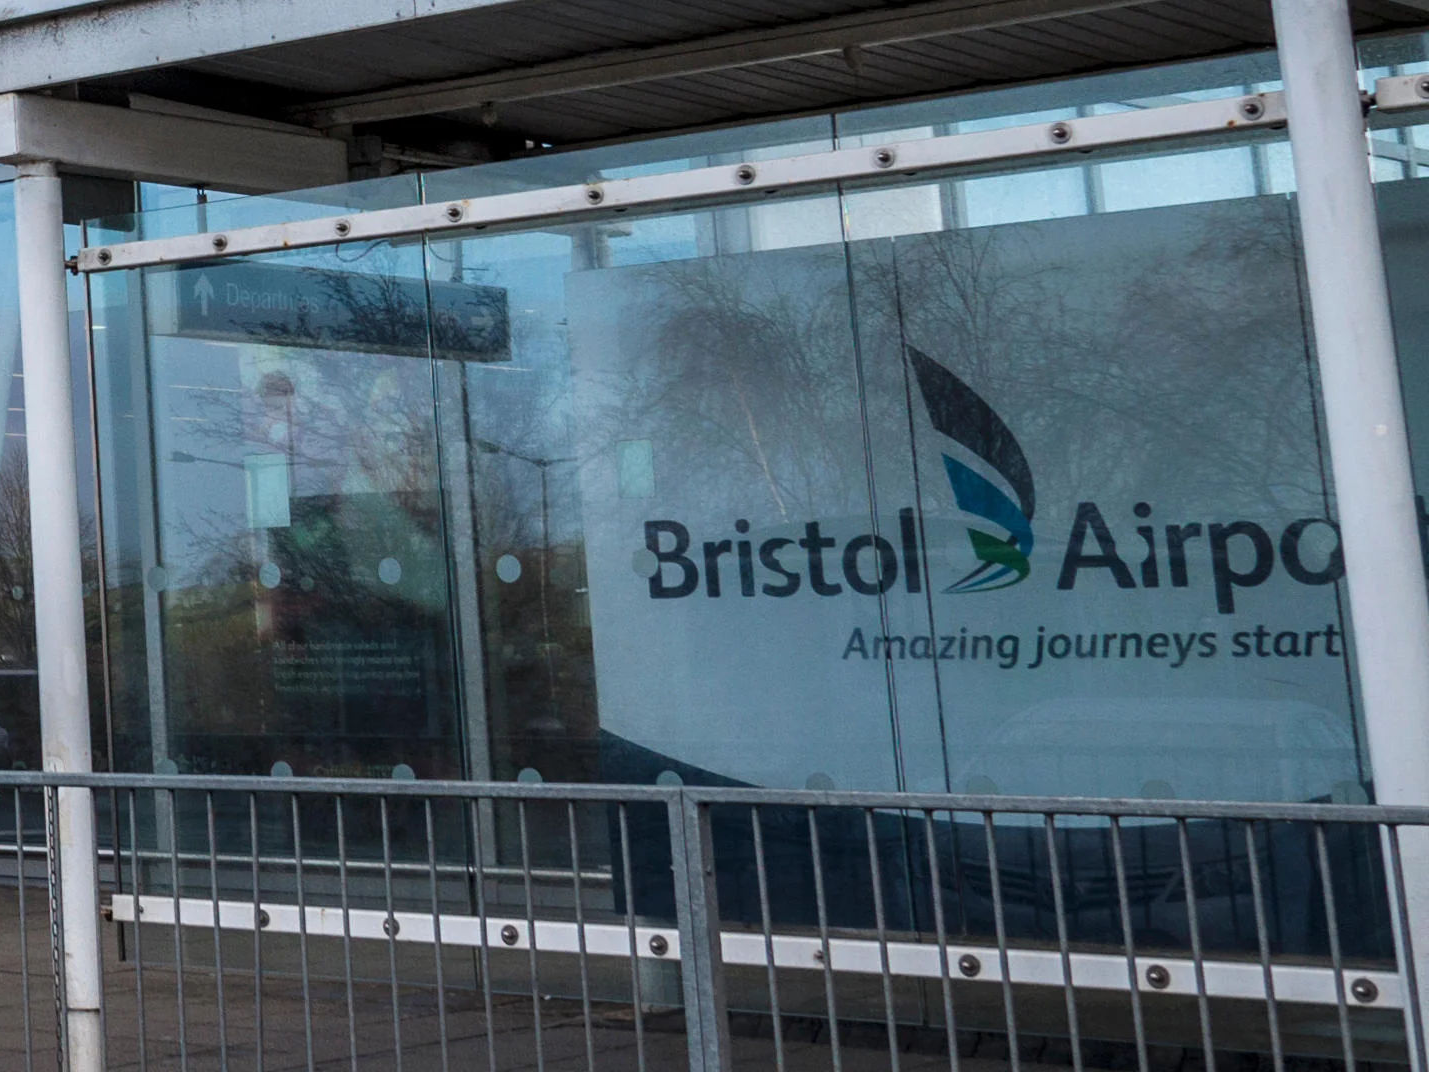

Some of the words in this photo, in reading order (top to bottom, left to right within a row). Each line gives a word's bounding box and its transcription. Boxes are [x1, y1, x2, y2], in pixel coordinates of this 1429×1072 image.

[644, 507, 922, 600] Bristol
[842, 627, 1020, 670] Amazing
[1030, 625, 1218, 670] journeys
[1231, 623, 1341, 659] start
